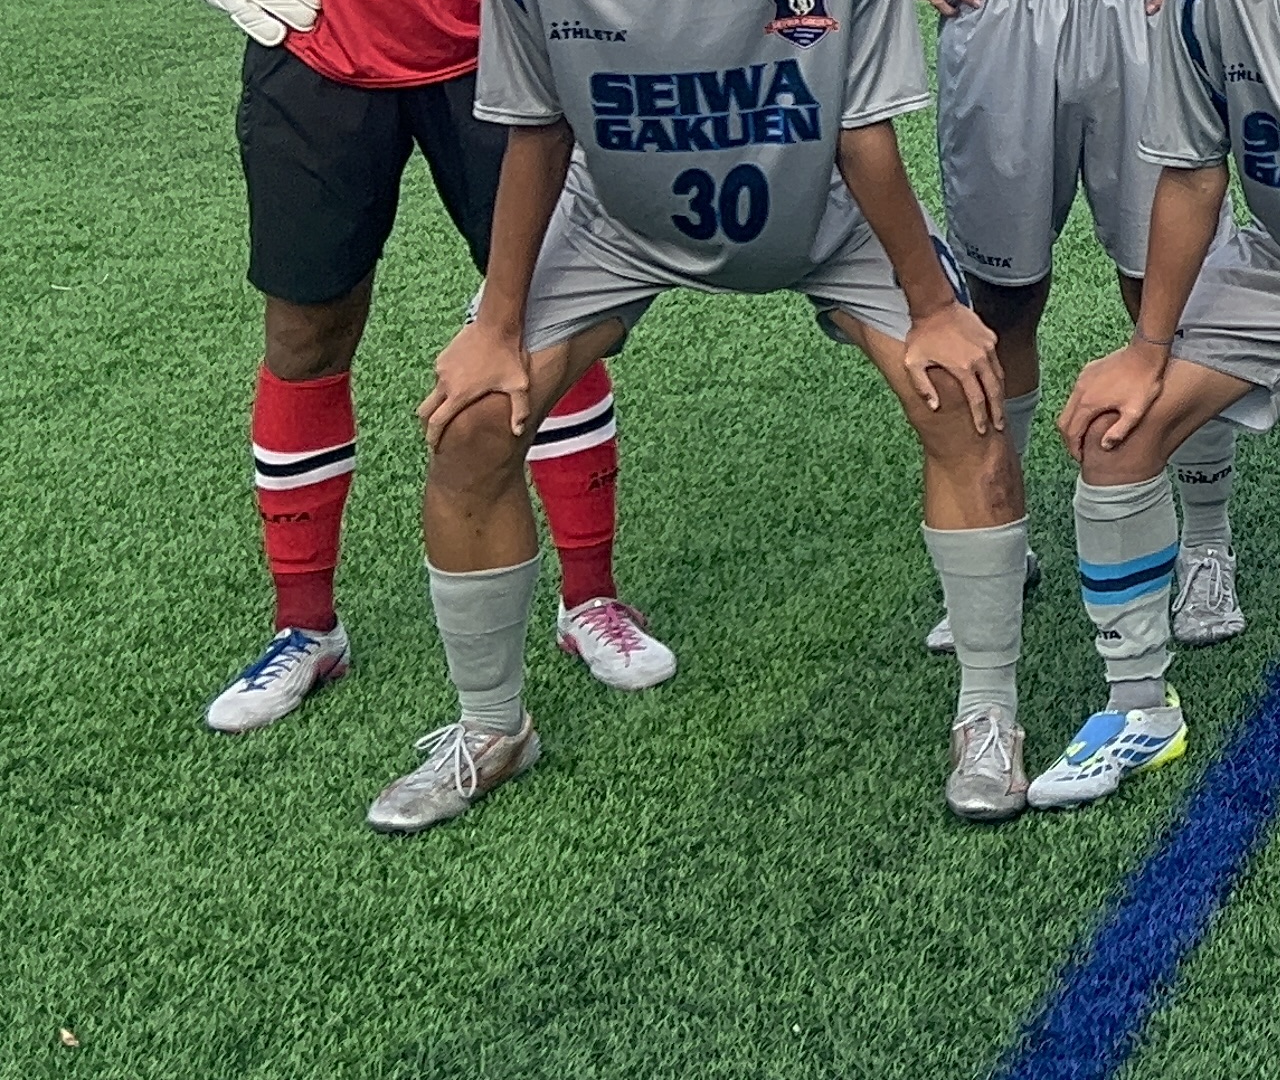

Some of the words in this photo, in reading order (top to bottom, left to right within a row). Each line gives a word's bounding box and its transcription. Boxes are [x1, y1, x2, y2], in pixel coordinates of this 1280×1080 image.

[550, 27, 627, 43] ATHLETA
[589, 59, 820, 118] SEIWA
[593, 107, 823, 154] GAKUEN
[671, 163, 770, 244] 30
